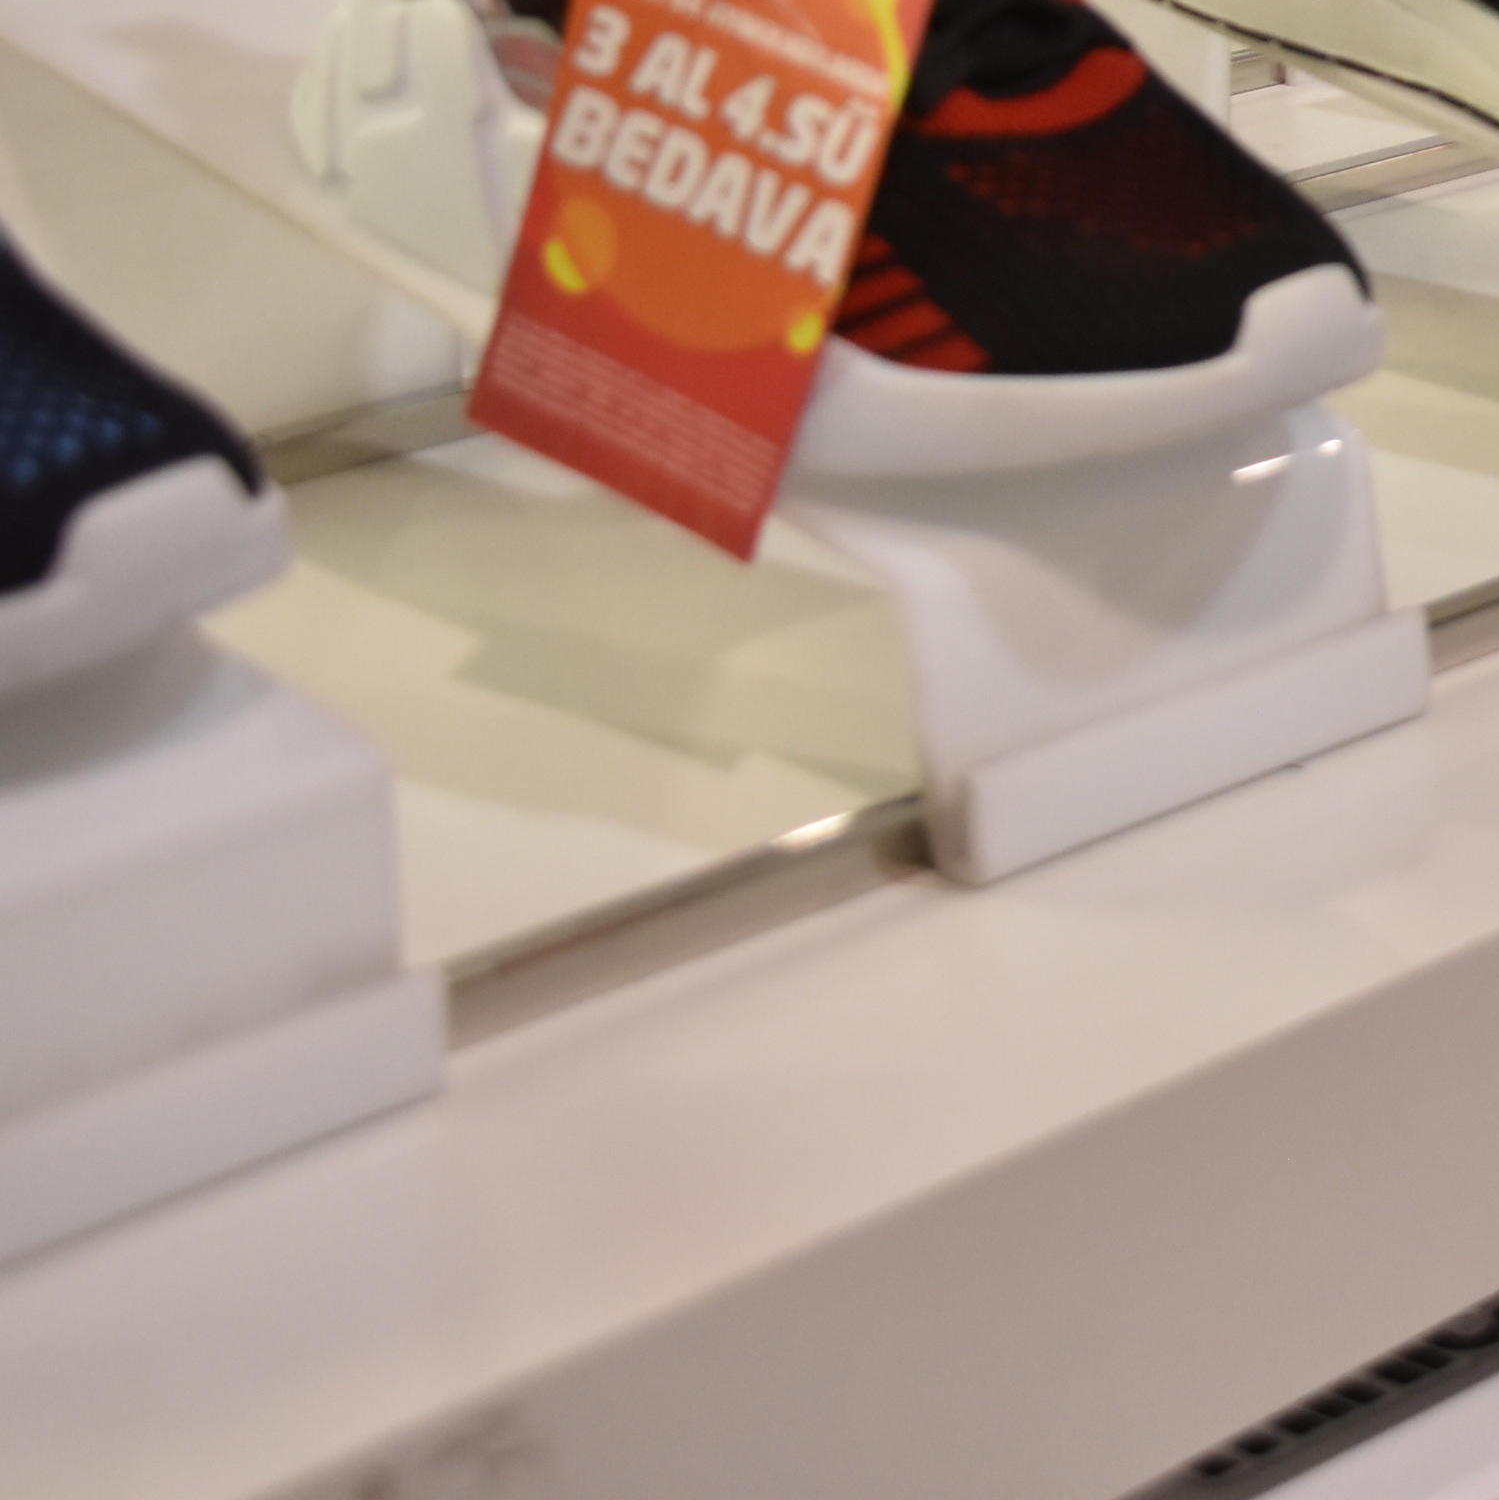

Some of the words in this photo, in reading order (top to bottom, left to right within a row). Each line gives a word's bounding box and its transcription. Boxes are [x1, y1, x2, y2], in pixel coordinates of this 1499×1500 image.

[550, 86, 856, 287] BEDAVA
[574, 4, 632, 77] 3
[631, 31, 719, 121] AL
[721, 74, 879, 187] 4.SÜ
